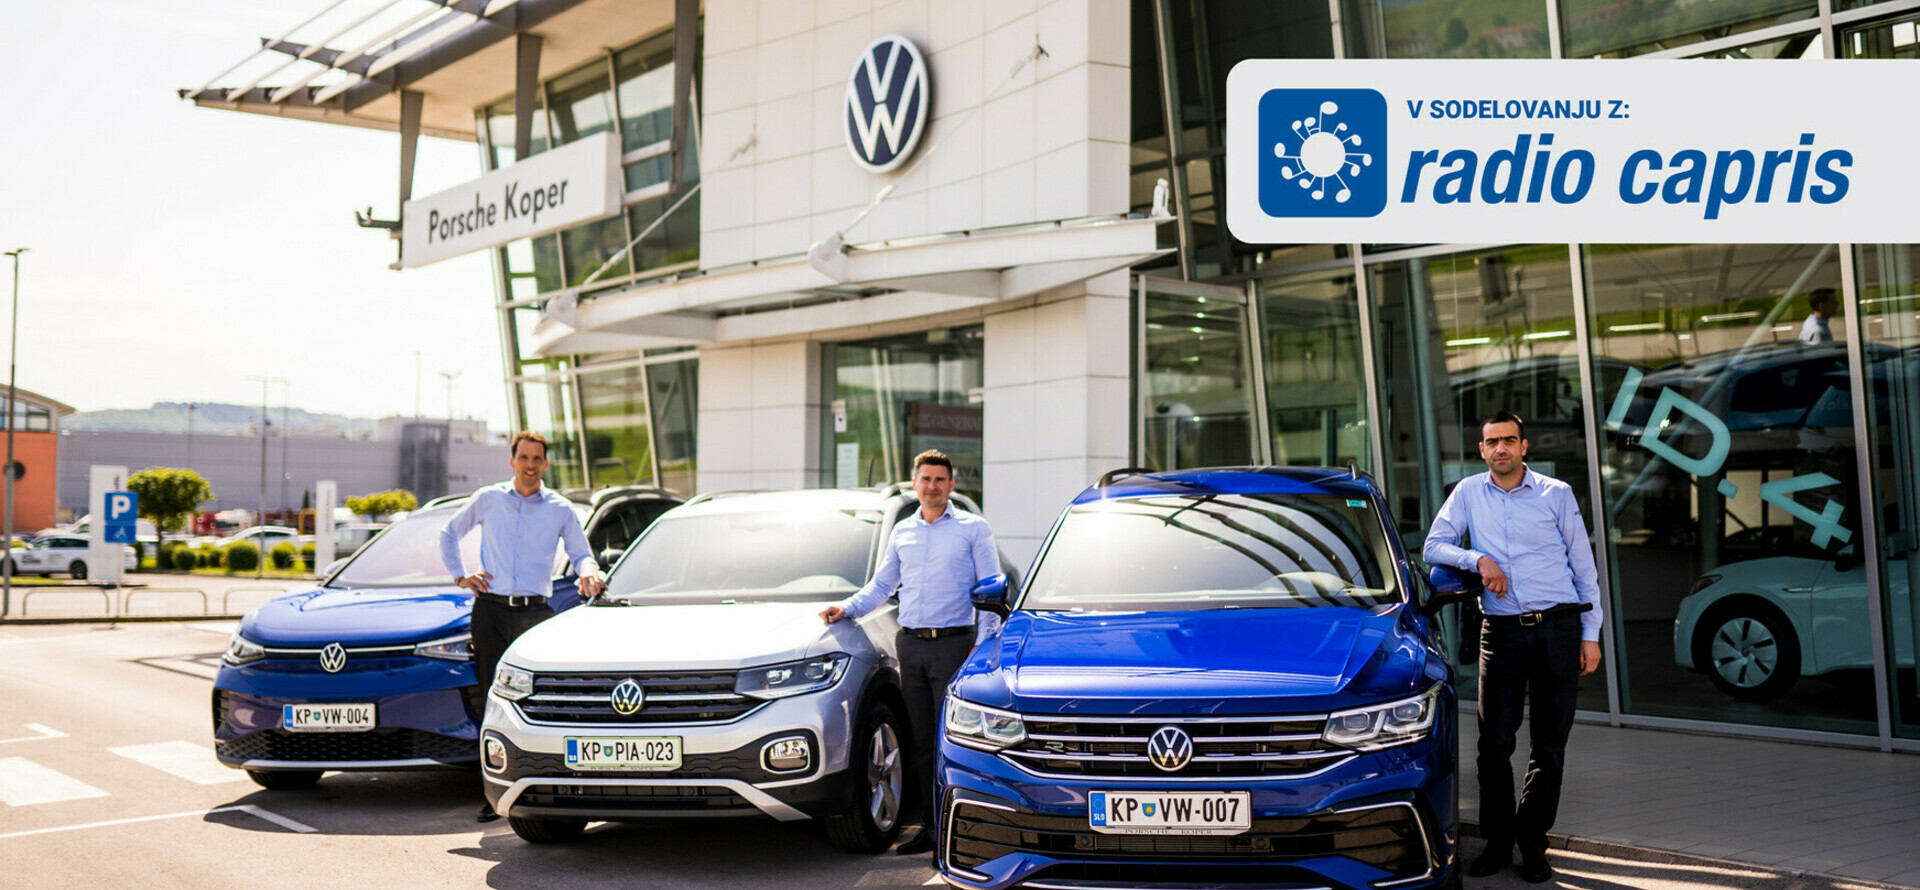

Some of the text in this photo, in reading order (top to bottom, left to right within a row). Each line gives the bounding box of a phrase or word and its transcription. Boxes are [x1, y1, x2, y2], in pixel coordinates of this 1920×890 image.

[429, 179, 568, 244] Porsche Koper
[1606, 366, 1853, 550] ID.4
[112, 495, 130, 519] P
[295, 708, 369, 724] KP VW-004
[582, 742, 674, 761] KP PIA-023
[1093, 813, 1105, 821] SLO
[1111, 798, 1240, 822] KP VW-007
